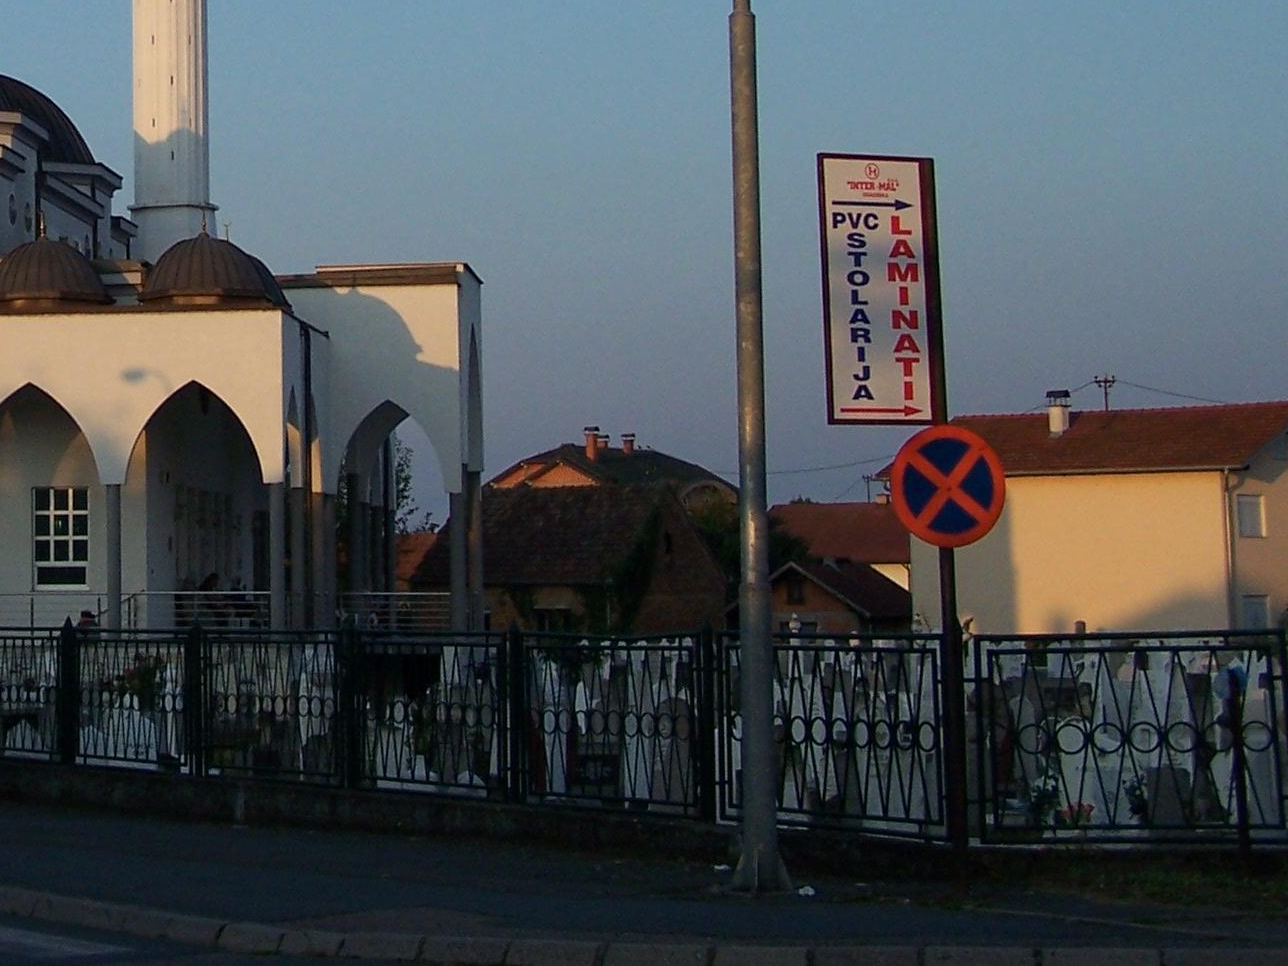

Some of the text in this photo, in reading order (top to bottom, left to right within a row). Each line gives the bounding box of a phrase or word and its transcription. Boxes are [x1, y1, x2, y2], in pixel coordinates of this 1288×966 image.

[832, 212, 879, 230] PVC
[847, 232, 875, 400] STOLARIJA
[887, 216, 920, 401] LAMINATI
